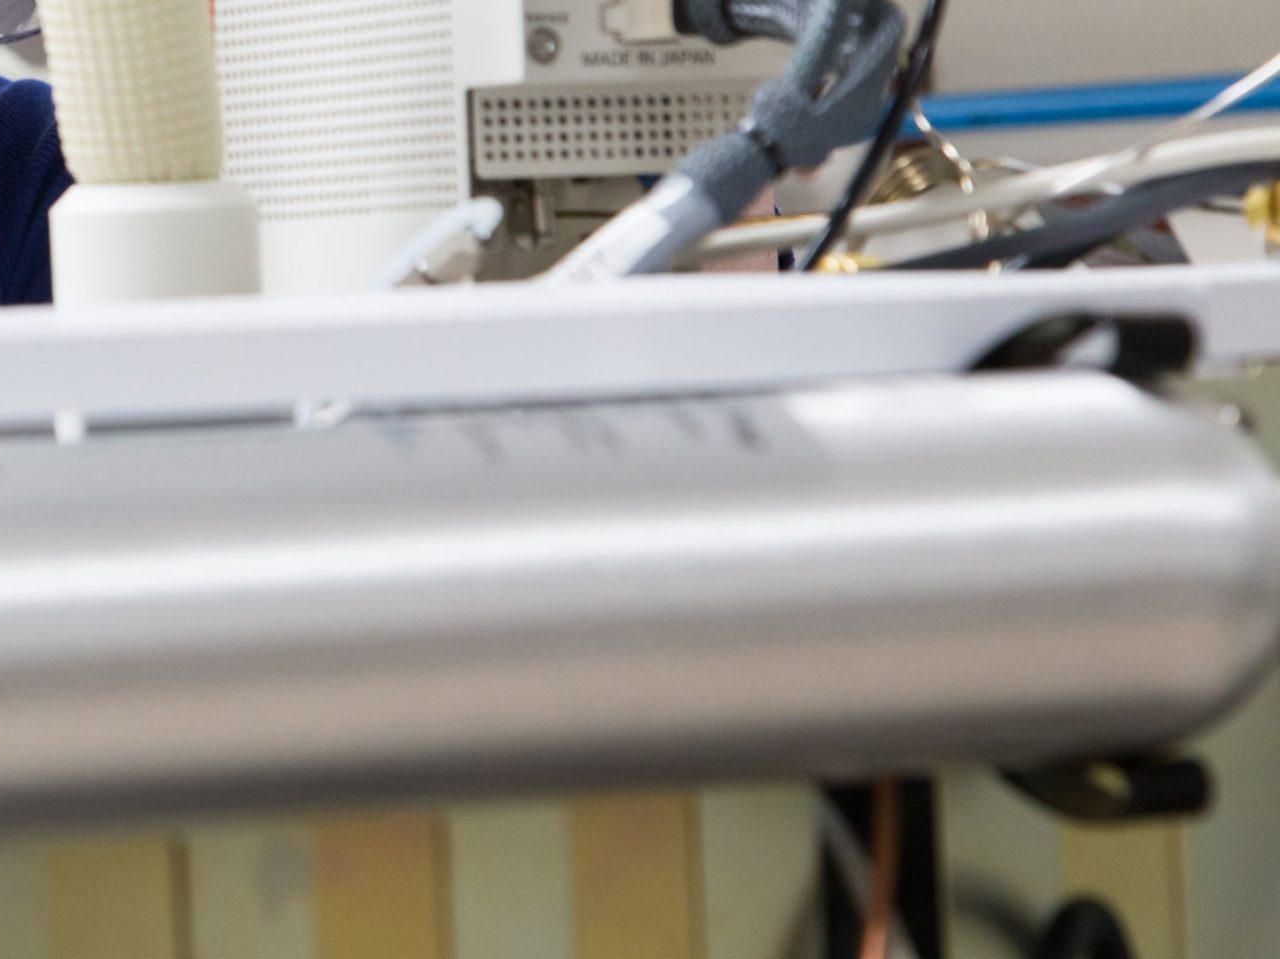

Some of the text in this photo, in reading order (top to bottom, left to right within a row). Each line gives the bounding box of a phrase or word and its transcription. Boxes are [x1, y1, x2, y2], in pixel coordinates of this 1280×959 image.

[582, 47, 717, 66] MADE IN JAPAN
